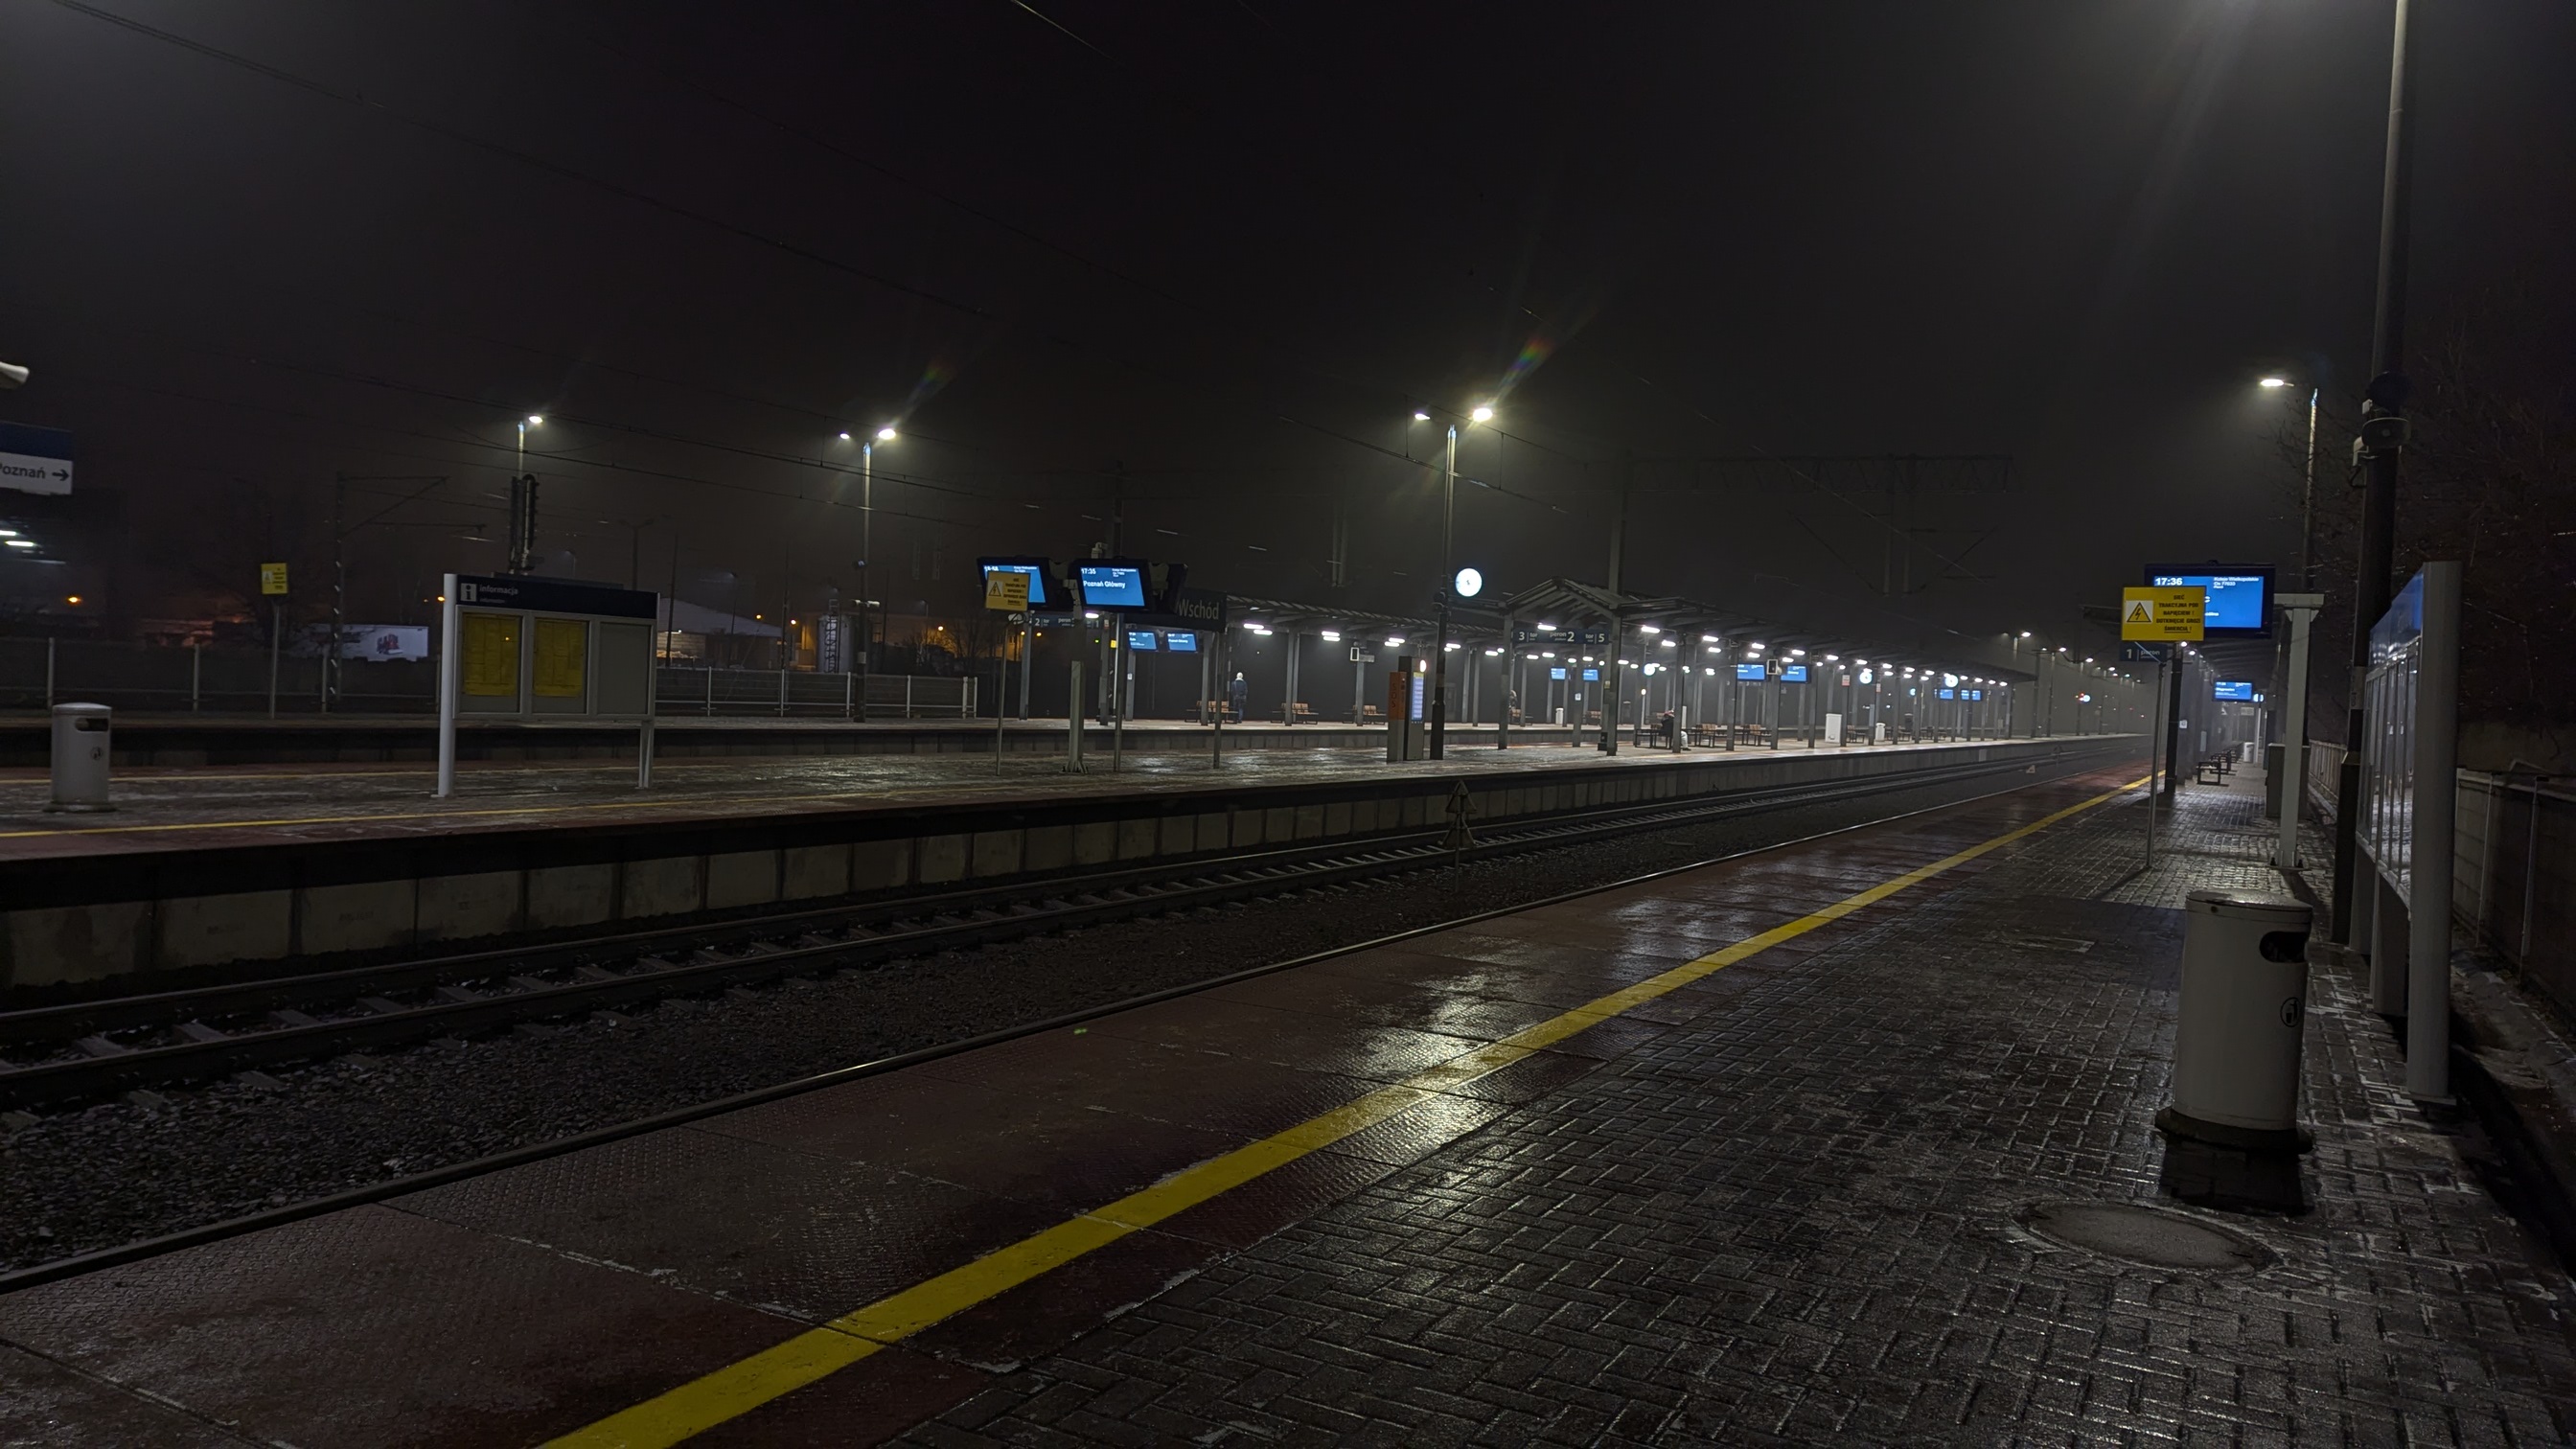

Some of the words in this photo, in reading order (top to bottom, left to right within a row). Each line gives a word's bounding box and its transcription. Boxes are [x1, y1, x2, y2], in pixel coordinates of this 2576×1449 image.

[2155, 577, 2183, 586] 17:36
[479, 585, 519, 596] informacja
[1179, 598, 1220, 620] Wschód
[1034, 617, 1041, 627] 2
[1518, 631, 1526, 641] 3
[1567, 631, 1576, 642] 2
[1598, 632, 1605, 643] 5
[2126, 648, 2132, 659] 1
